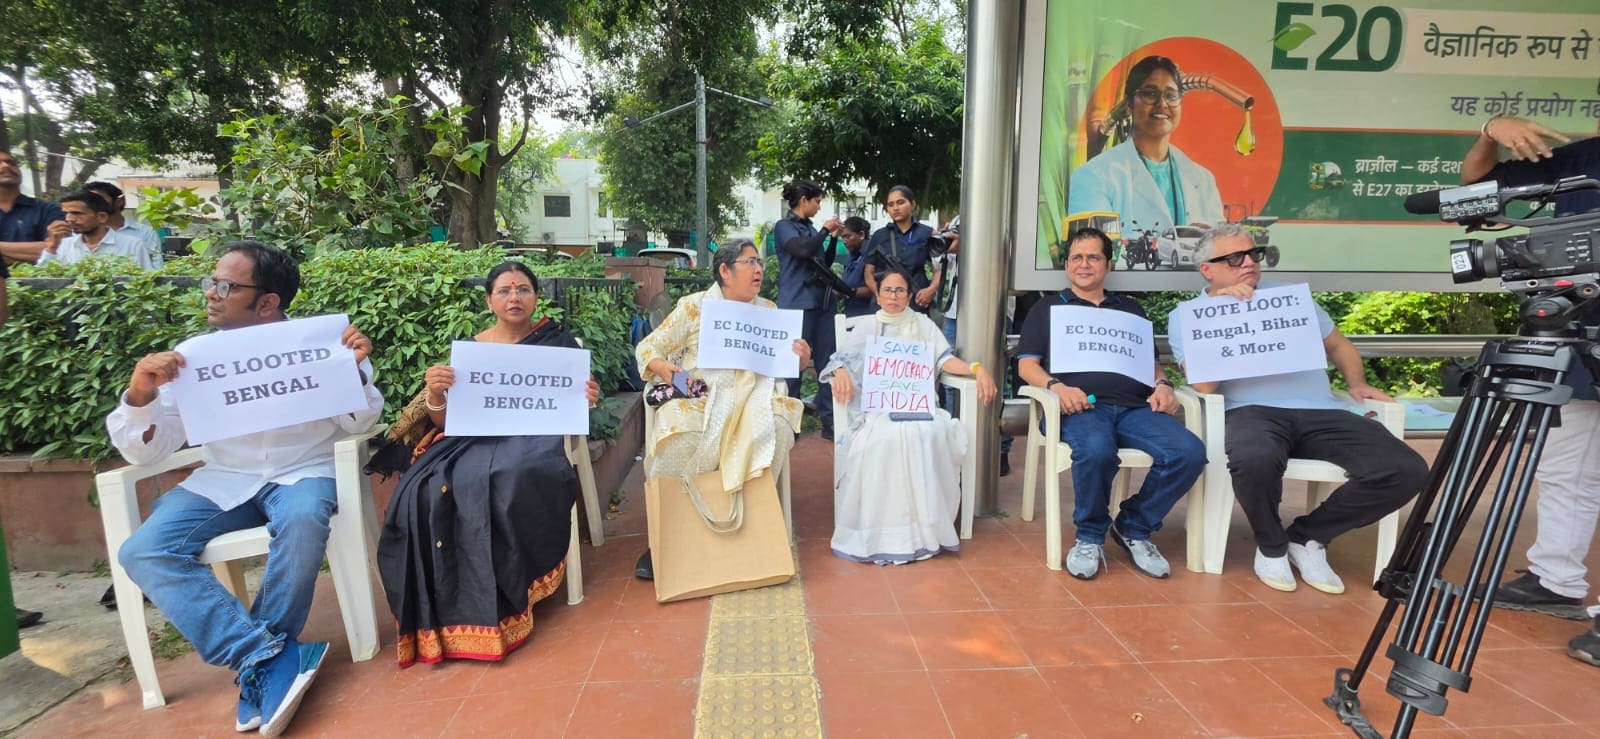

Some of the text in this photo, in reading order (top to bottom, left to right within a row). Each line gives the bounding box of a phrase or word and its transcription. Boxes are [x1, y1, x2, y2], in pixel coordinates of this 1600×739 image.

[1271, 1, 1403, 72] E20
[1424, 22, 1521, 58] वैज्ञानिक
[1526, 36, 1565, 60] रूप
[1571, 28, 1593, 61] से
[1451, 91, 1600, 118] यह कोई प्रयोग नह
[1417, 157, 1440, 174] कई
[1441, 160, 1463, 174] दश
[1352, 179, 1365, 196] से
[1367, 184, 1392, 196] E27
[1395, 183, 1413, 196] का
[1453, 254, 1466, 270] 023
[1192, 295, 1300, 320] VOTE LOOT:
[713, 320, 789, 340] EC LOOTED
[1065, 325, 1143, 345] EC LOOTED
[1192, 317, 1309, 341] Bengal, Bihar
[723, 338, 776, 357] BENGAL
[882, 341, 920, 356] SAVE
[1078, 341, 1136, 359] BENGAL
[1221, 341, 1287, 358] & More
[195, 347, 332, 383] EC LOOTED
[868, 355, 934, 381] DEMOCRACY
[469, 371, 573, 388] EC LOOTED
[879, 379, 920, 392] SAVE
[222, 375, 319, 406] BENGAL
[483, 396, 558, 411] BENGAL
[867, 391, 930, 414] INDIA
